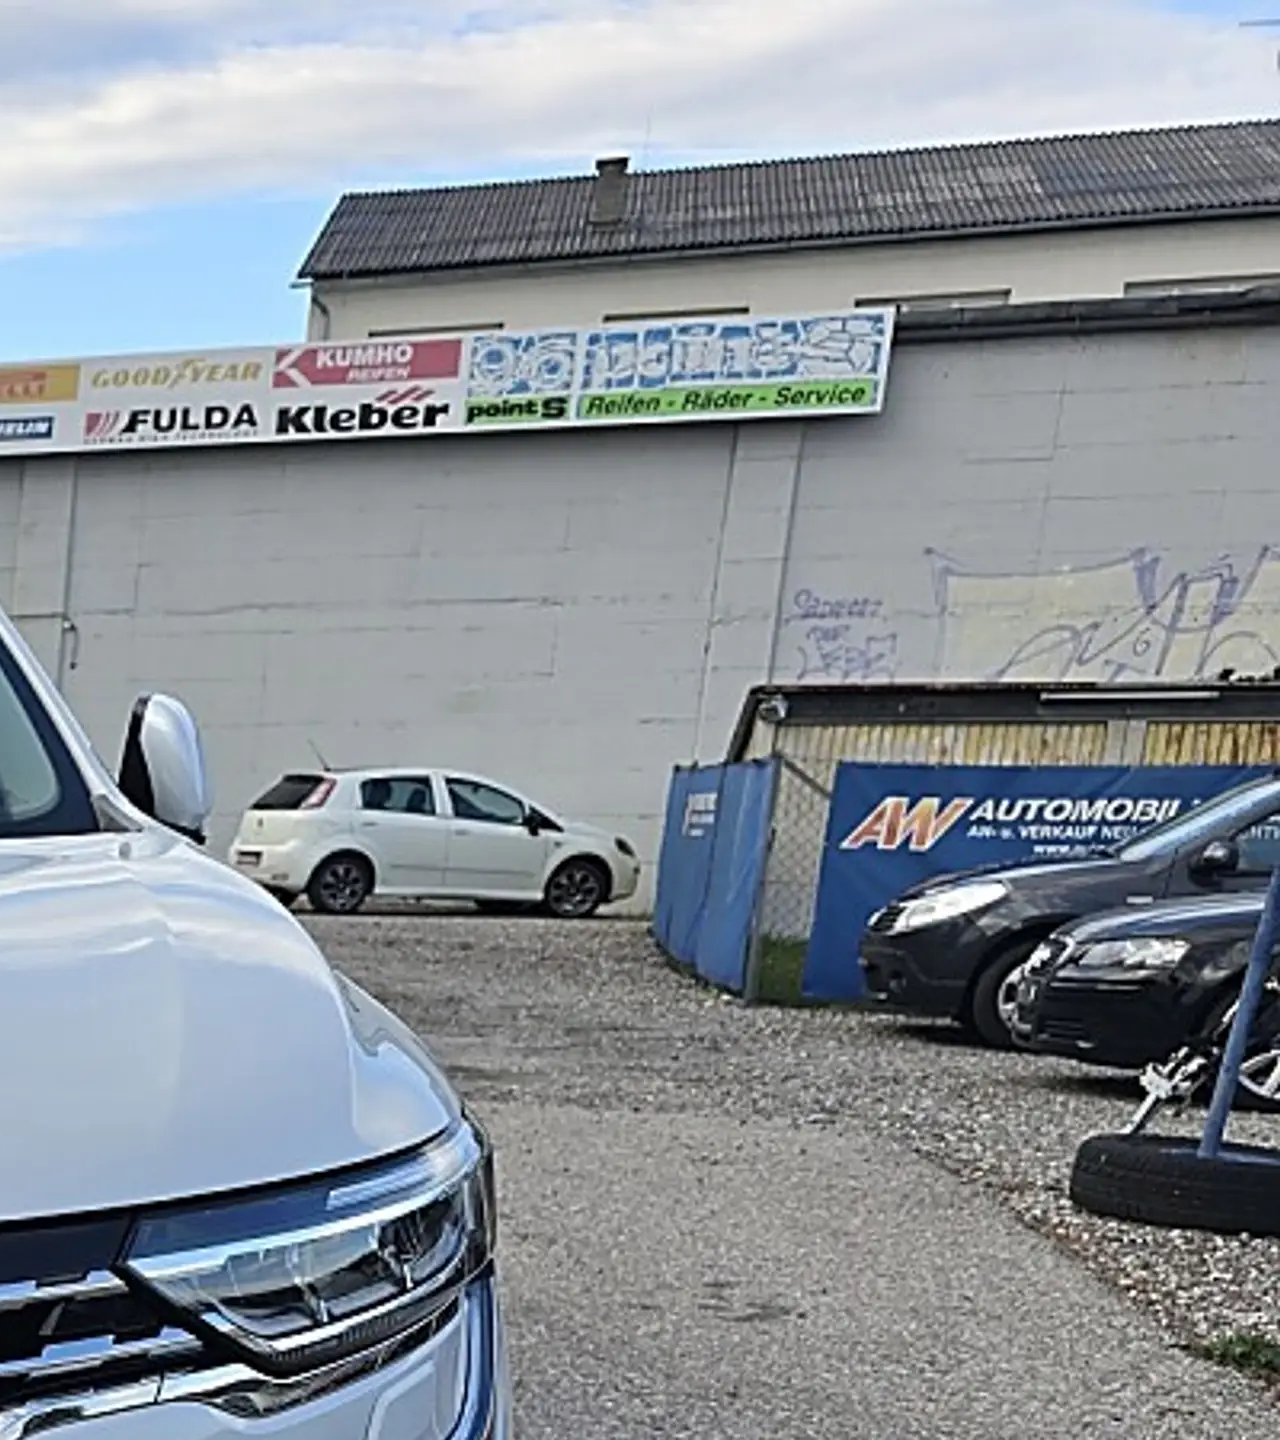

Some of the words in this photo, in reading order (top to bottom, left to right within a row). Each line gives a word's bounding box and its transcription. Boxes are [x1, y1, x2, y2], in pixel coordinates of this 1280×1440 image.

[316, 343, 414, 369] KUMHO
[91, 358, 262, 388] GOODYEAR
[585, 395, 662, 415] Reifen
[684, 389, 751, 411] Räder
[773, 384, 866, 407] Service
[120, 403, 258, 433] FULDA
[275, 402, 450, 434] Kleber
[840, 796, 975, 852] AW
[968, 797, 1182, 823] AUTOMOBIL
[1018, 824, 1099, 840] VERKAUF
